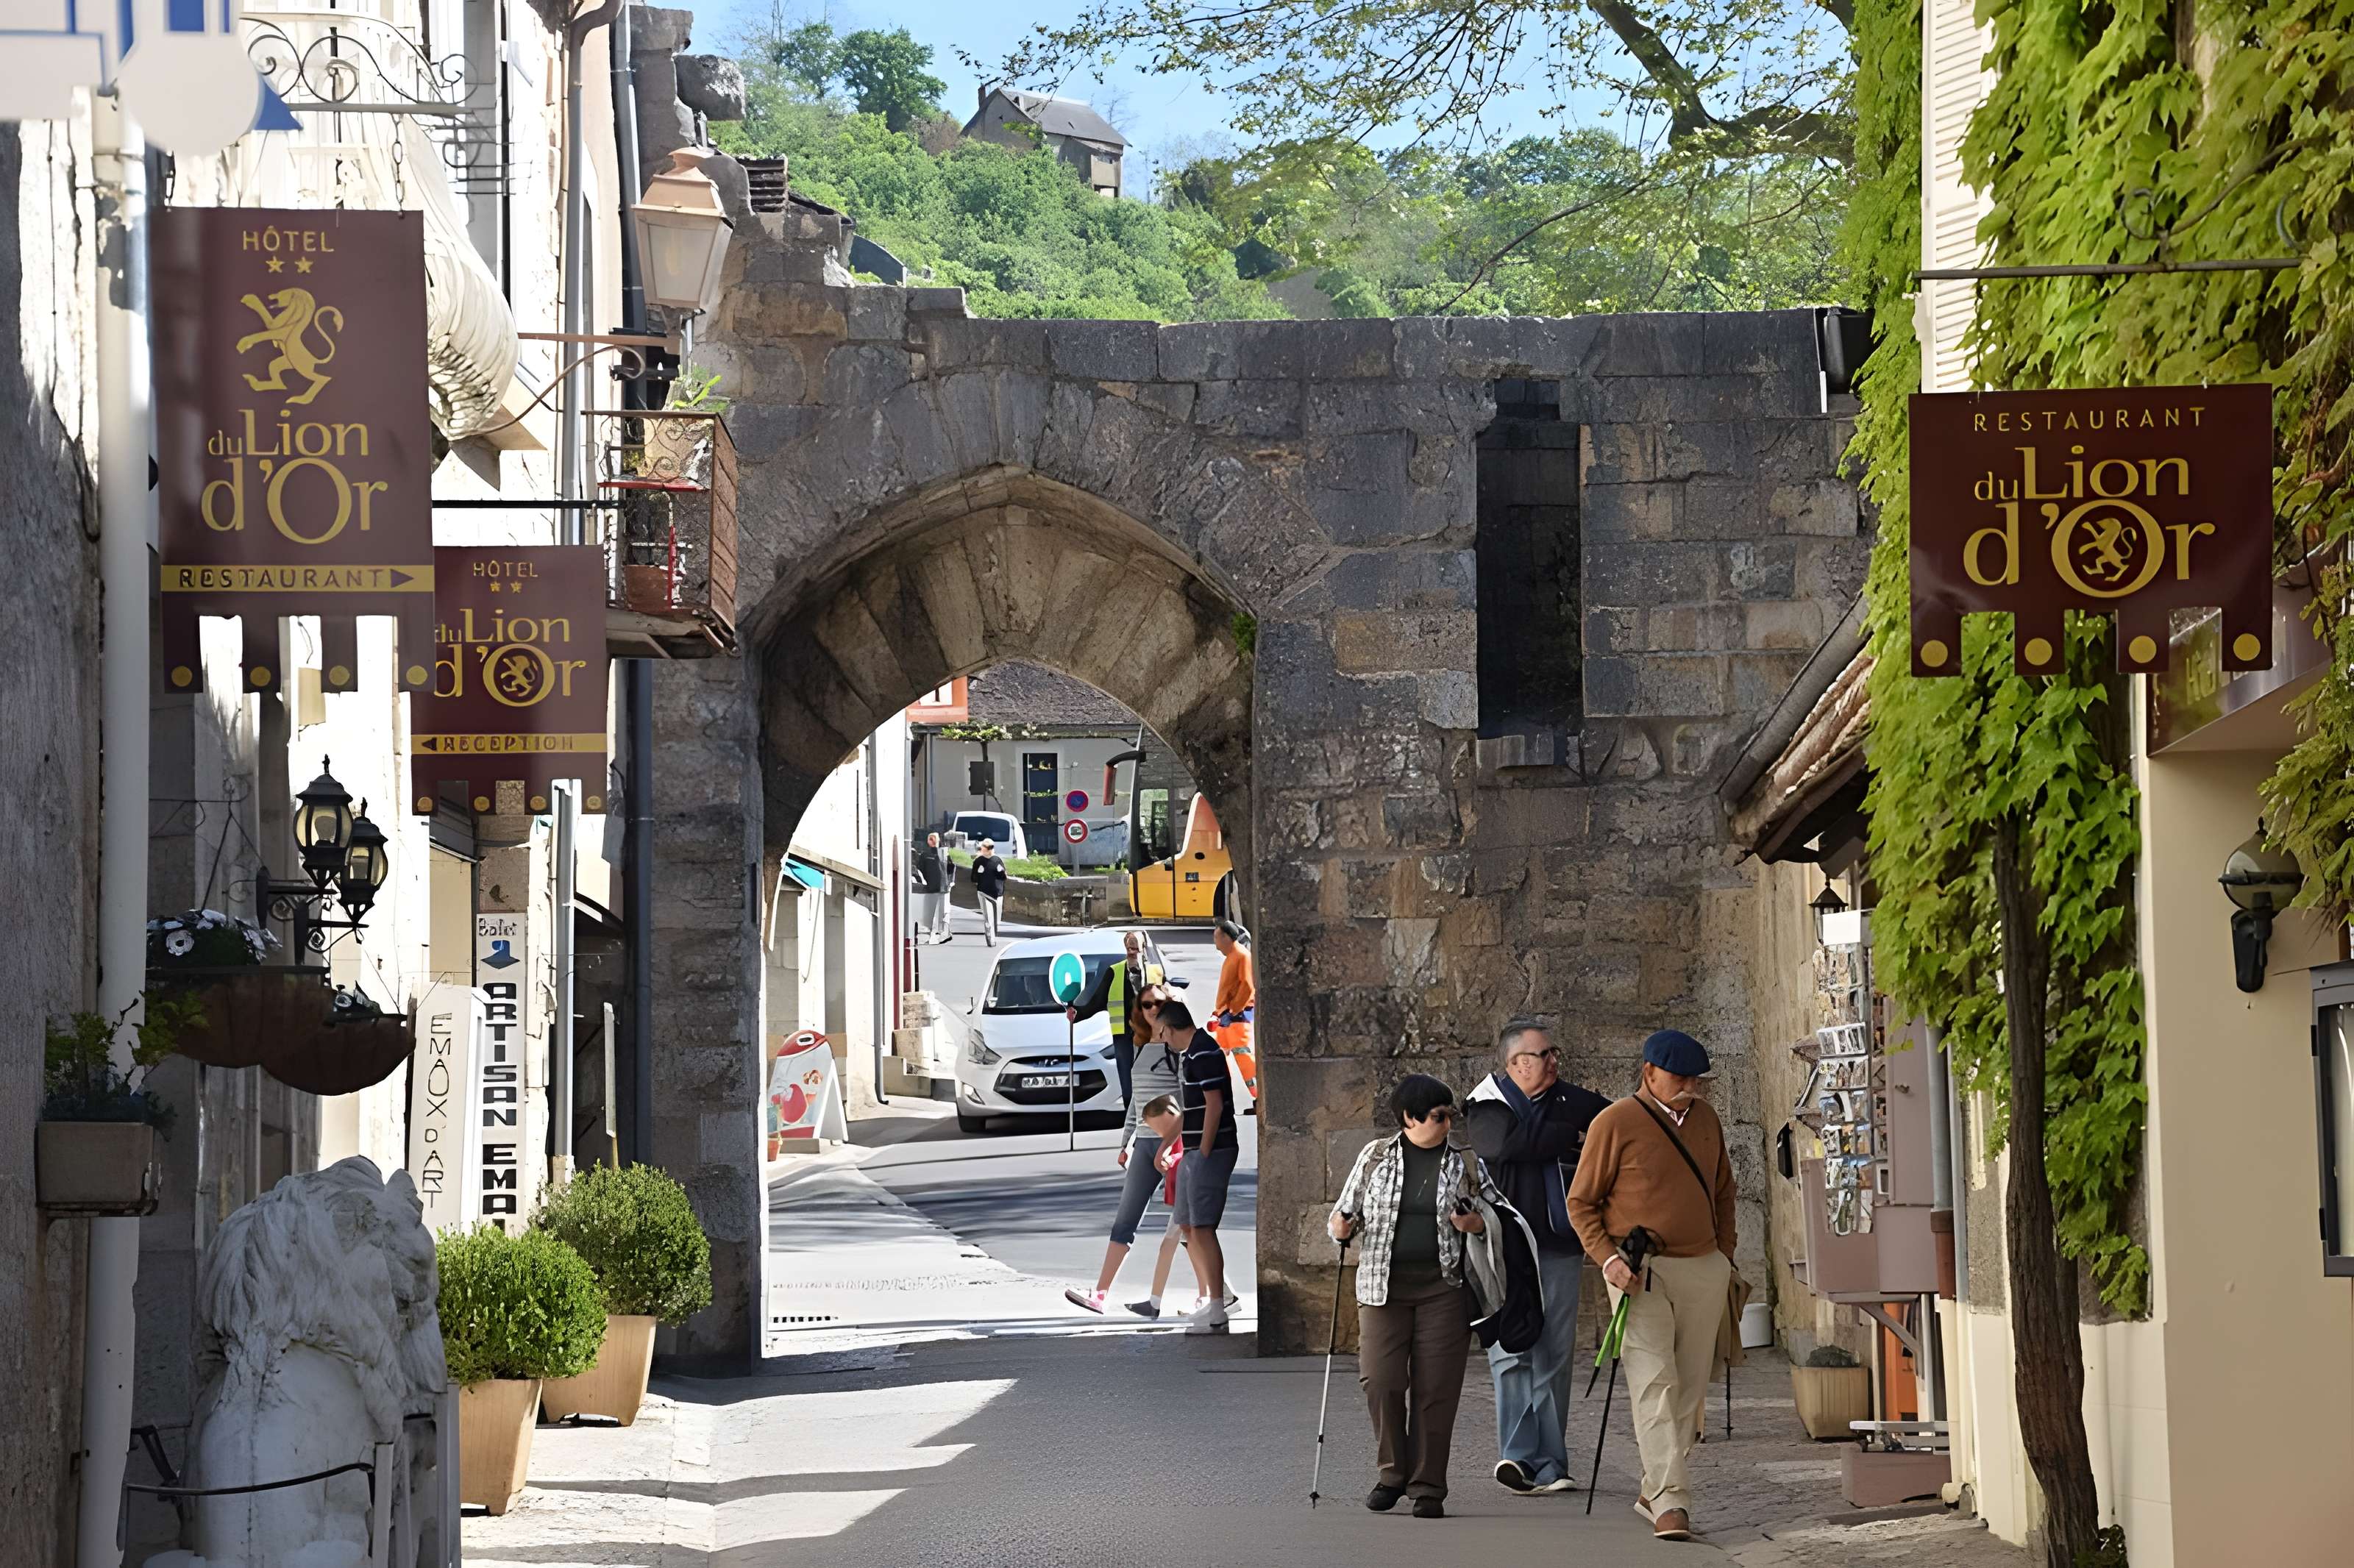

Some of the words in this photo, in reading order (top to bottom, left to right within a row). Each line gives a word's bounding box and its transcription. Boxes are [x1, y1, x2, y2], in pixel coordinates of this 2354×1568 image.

[243, 225, 335, 252] HÔTEL
[207, 430, 242, 455] du
[238, 409, 369, 456] Lion
[1974, 406, 2205, 432] RESTAURANT
[1974, 471, 2018, 501] du
[2014, 444, 2190, 499] Lion
[201, 457, 388, 544] d'Or
[473, 560, 538, 578] HÔTEL
[1963, 499, 2216, 599] d'Or
[179, 568, 384, 589] RESTAURANT
[459, 607, 571, 643] Lion
[433, 643, 587, 707] d'Or
[482, 982, 517, 1127] ARTISAN
